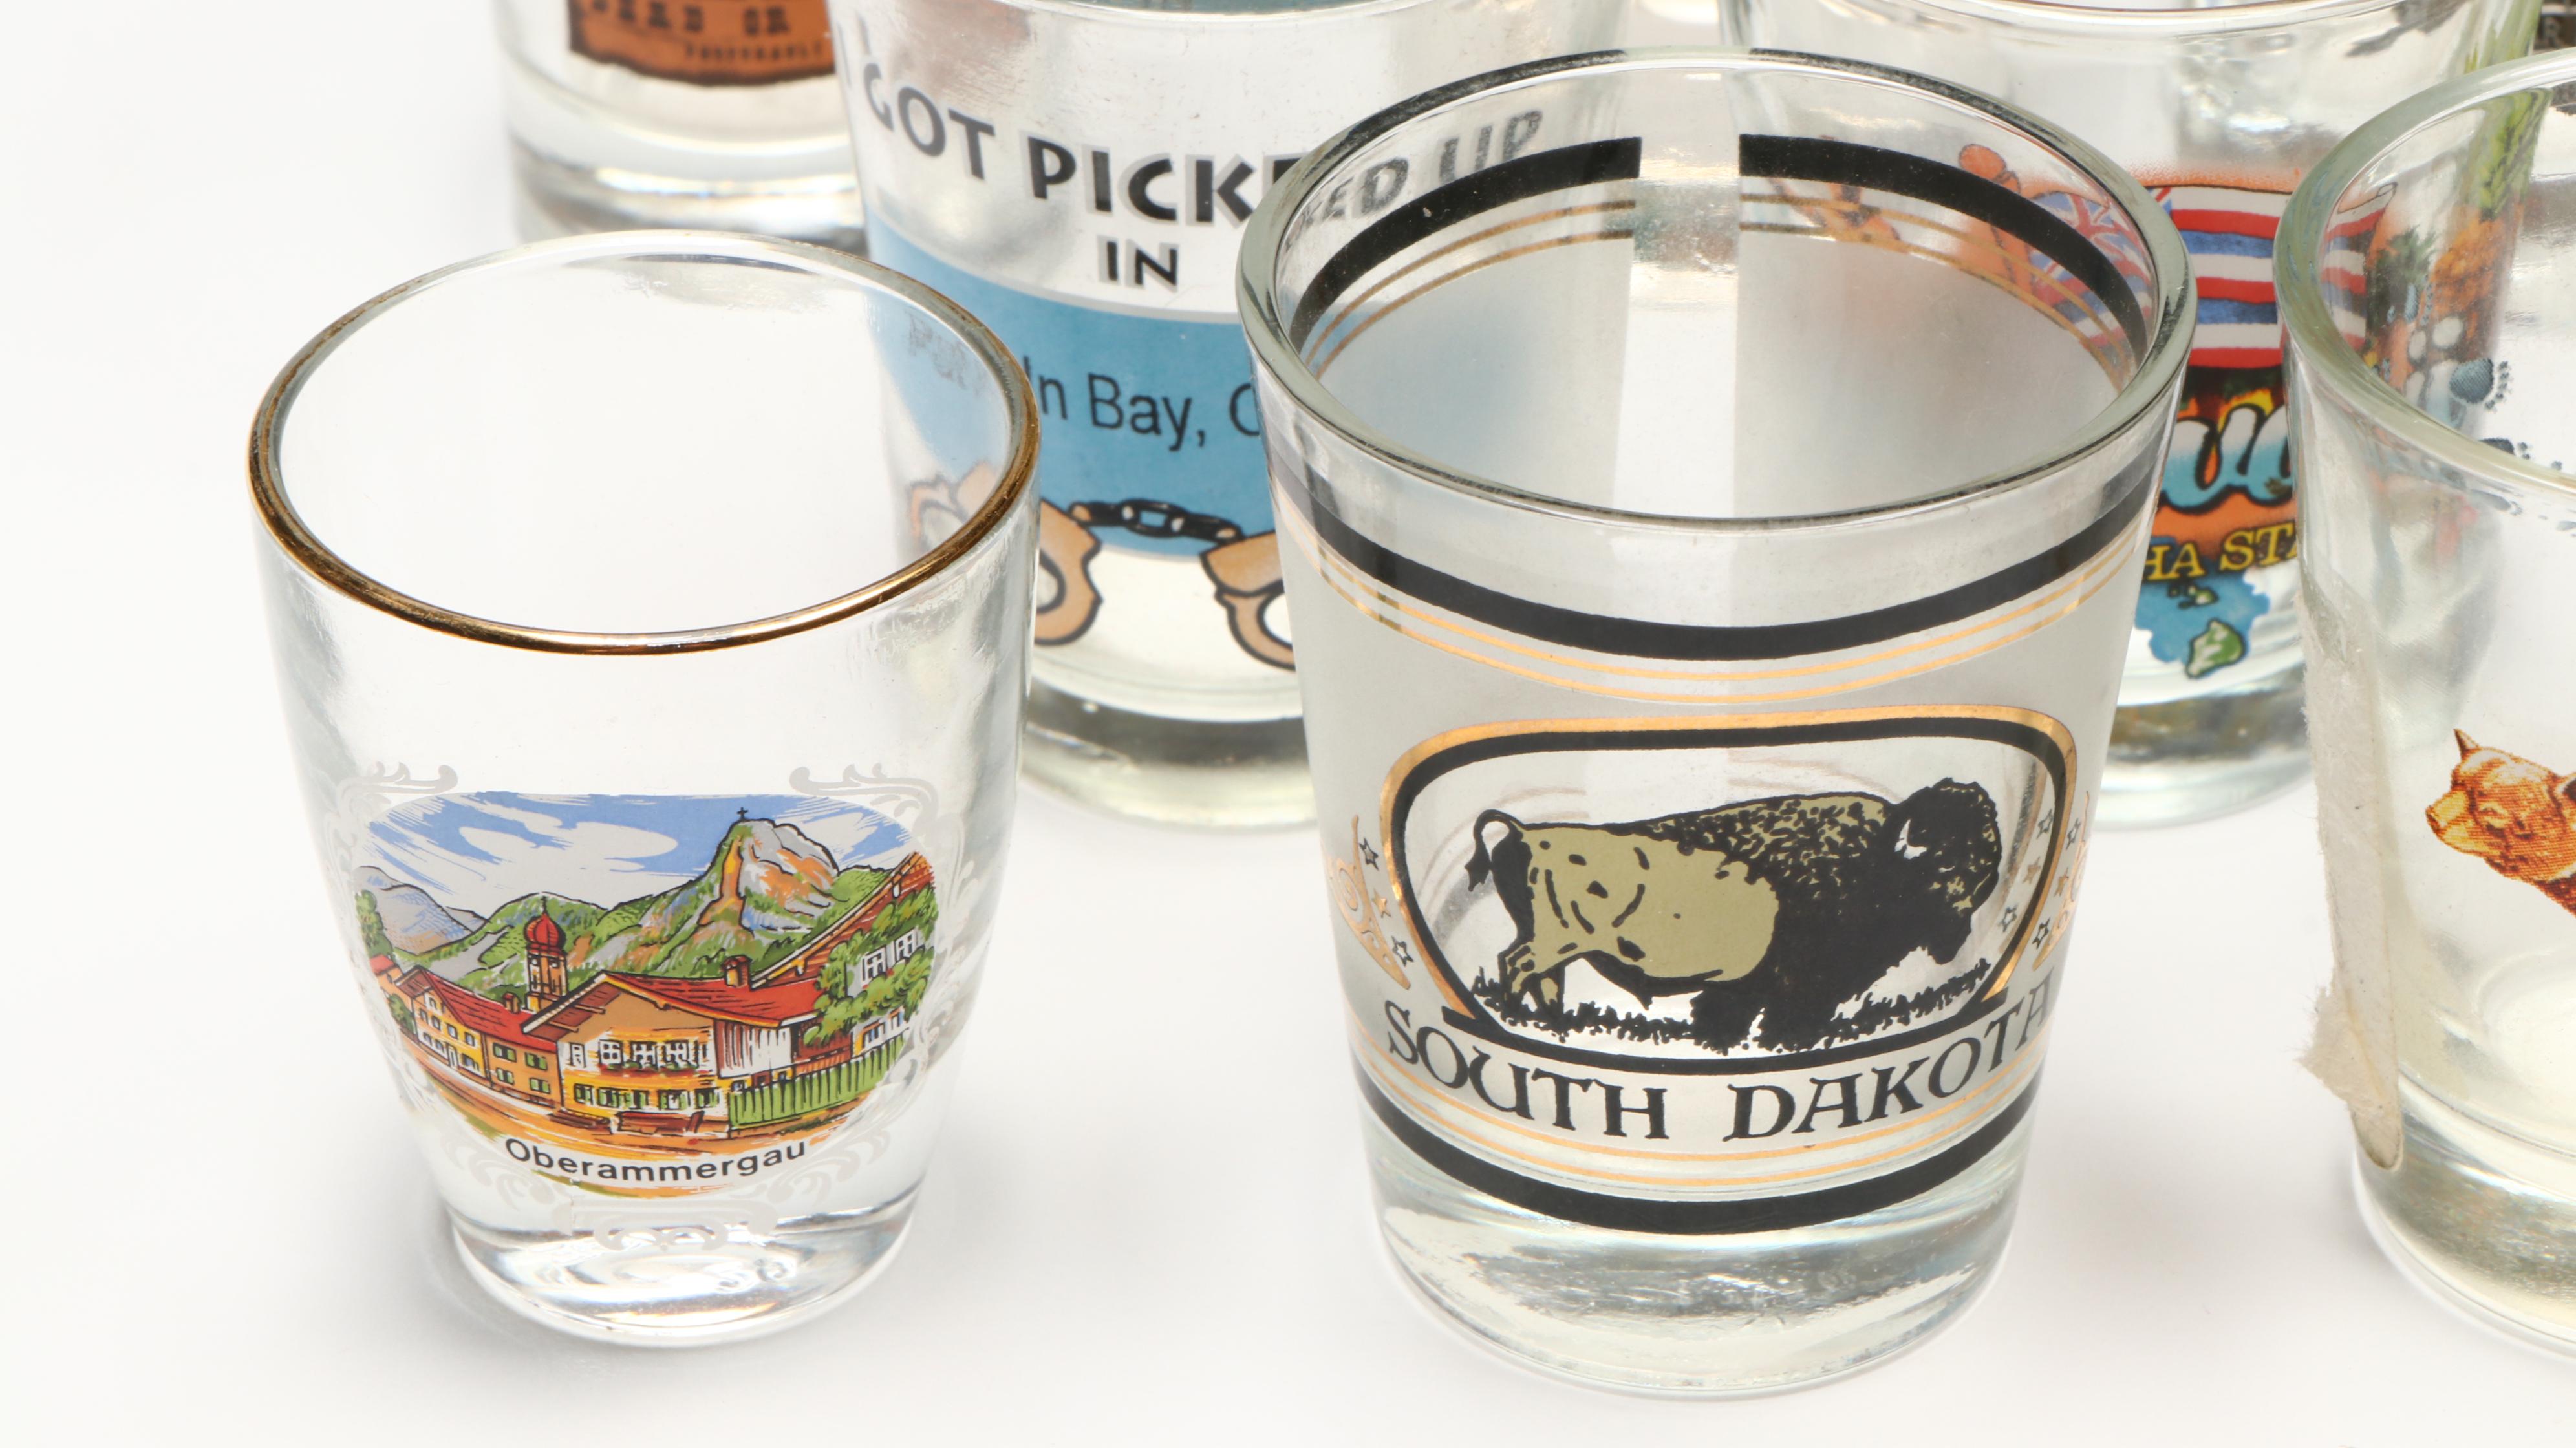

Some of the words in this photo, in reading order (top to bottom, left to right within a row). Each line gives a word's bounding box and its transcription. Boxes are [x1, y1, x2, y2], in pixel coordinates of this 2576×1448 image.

[863, 62, 996, 181] GOT
[1438, 110, 1543, 184] UP
[1106, 240, 1178, 287] IN
[1088, 373, 1207, 451] Bay,
[1388, 1000, 1669, 1140] SOUTH
[1723, 966, 2055, 1142] DAKOTA
[505, 1137, 806, 1182] Oberammergau
